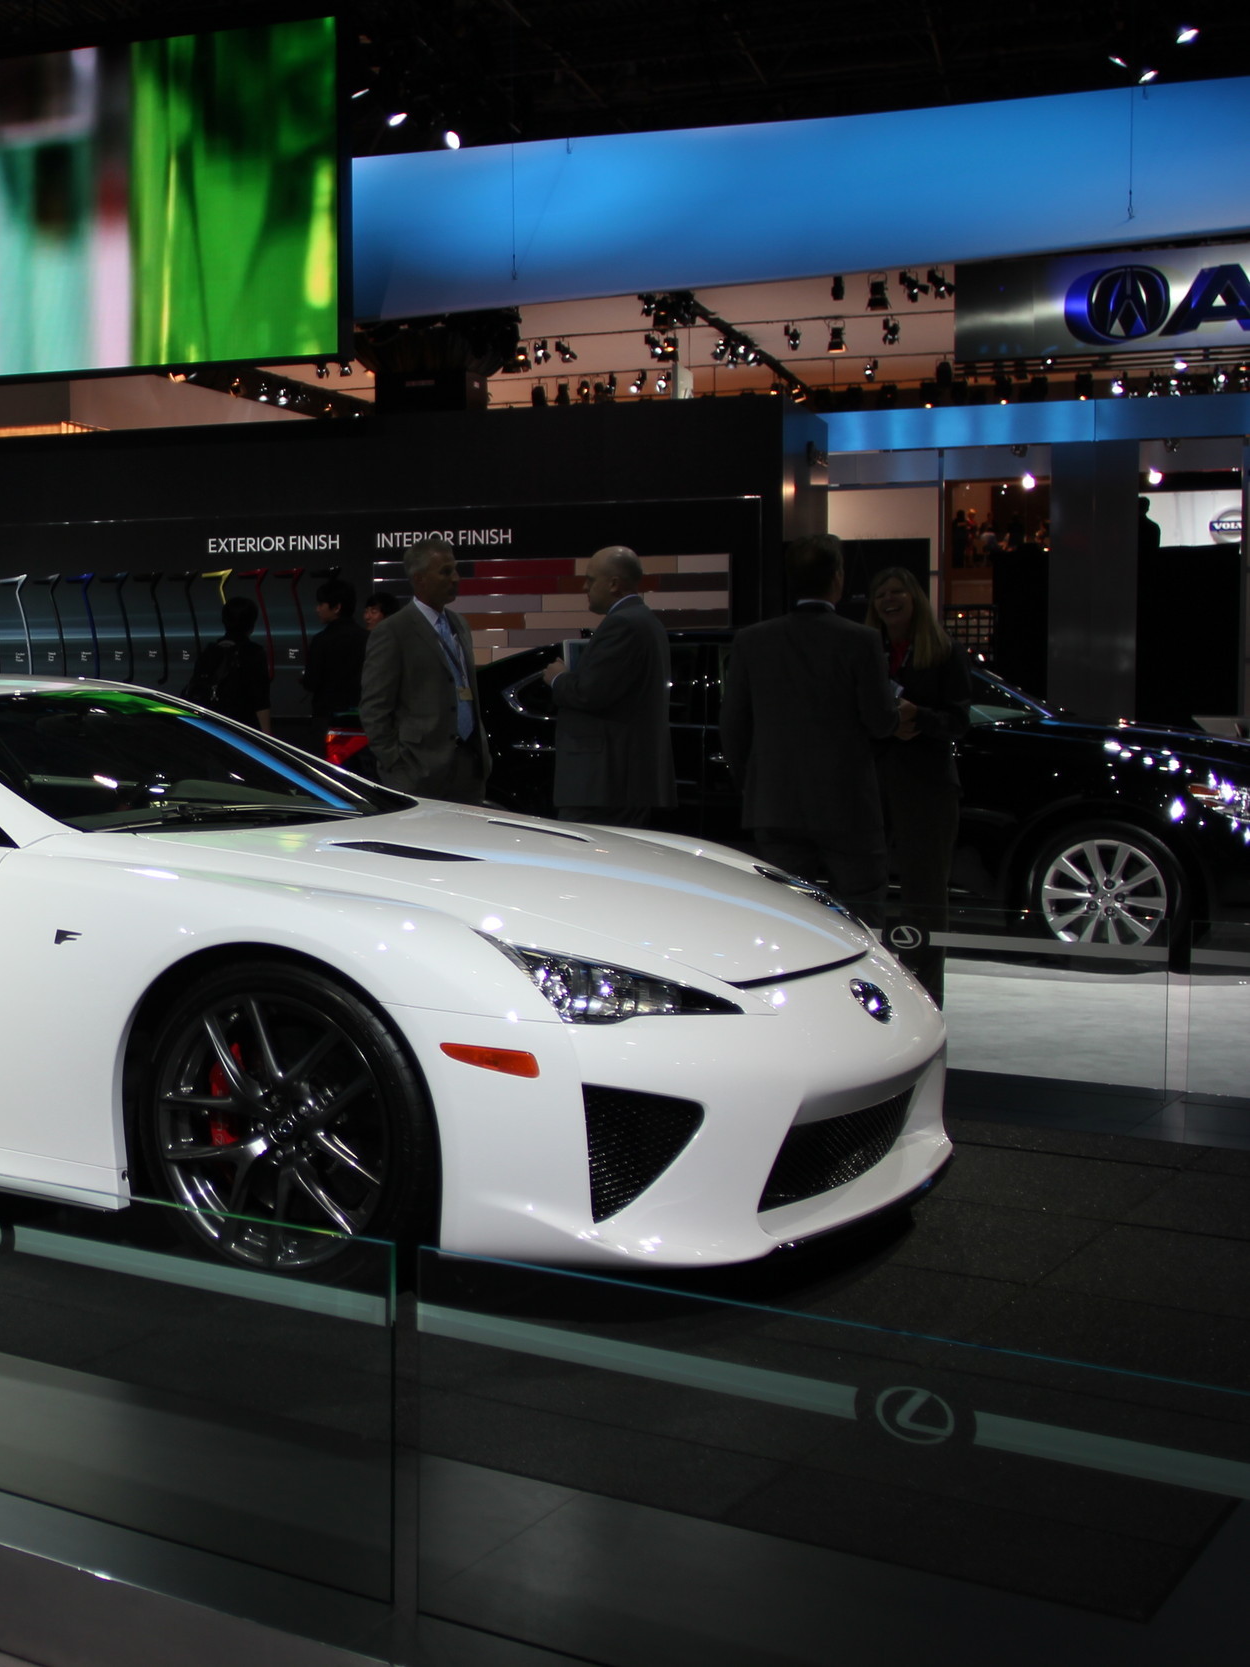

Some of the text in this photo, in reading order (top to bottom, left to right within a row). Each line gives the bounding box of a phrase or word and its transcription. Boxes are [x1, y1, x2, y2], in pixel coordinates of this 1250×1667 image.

[208, 534, 340, 553] EXTERIOR FINISH
[458, 528, 513, 546] FINISH
